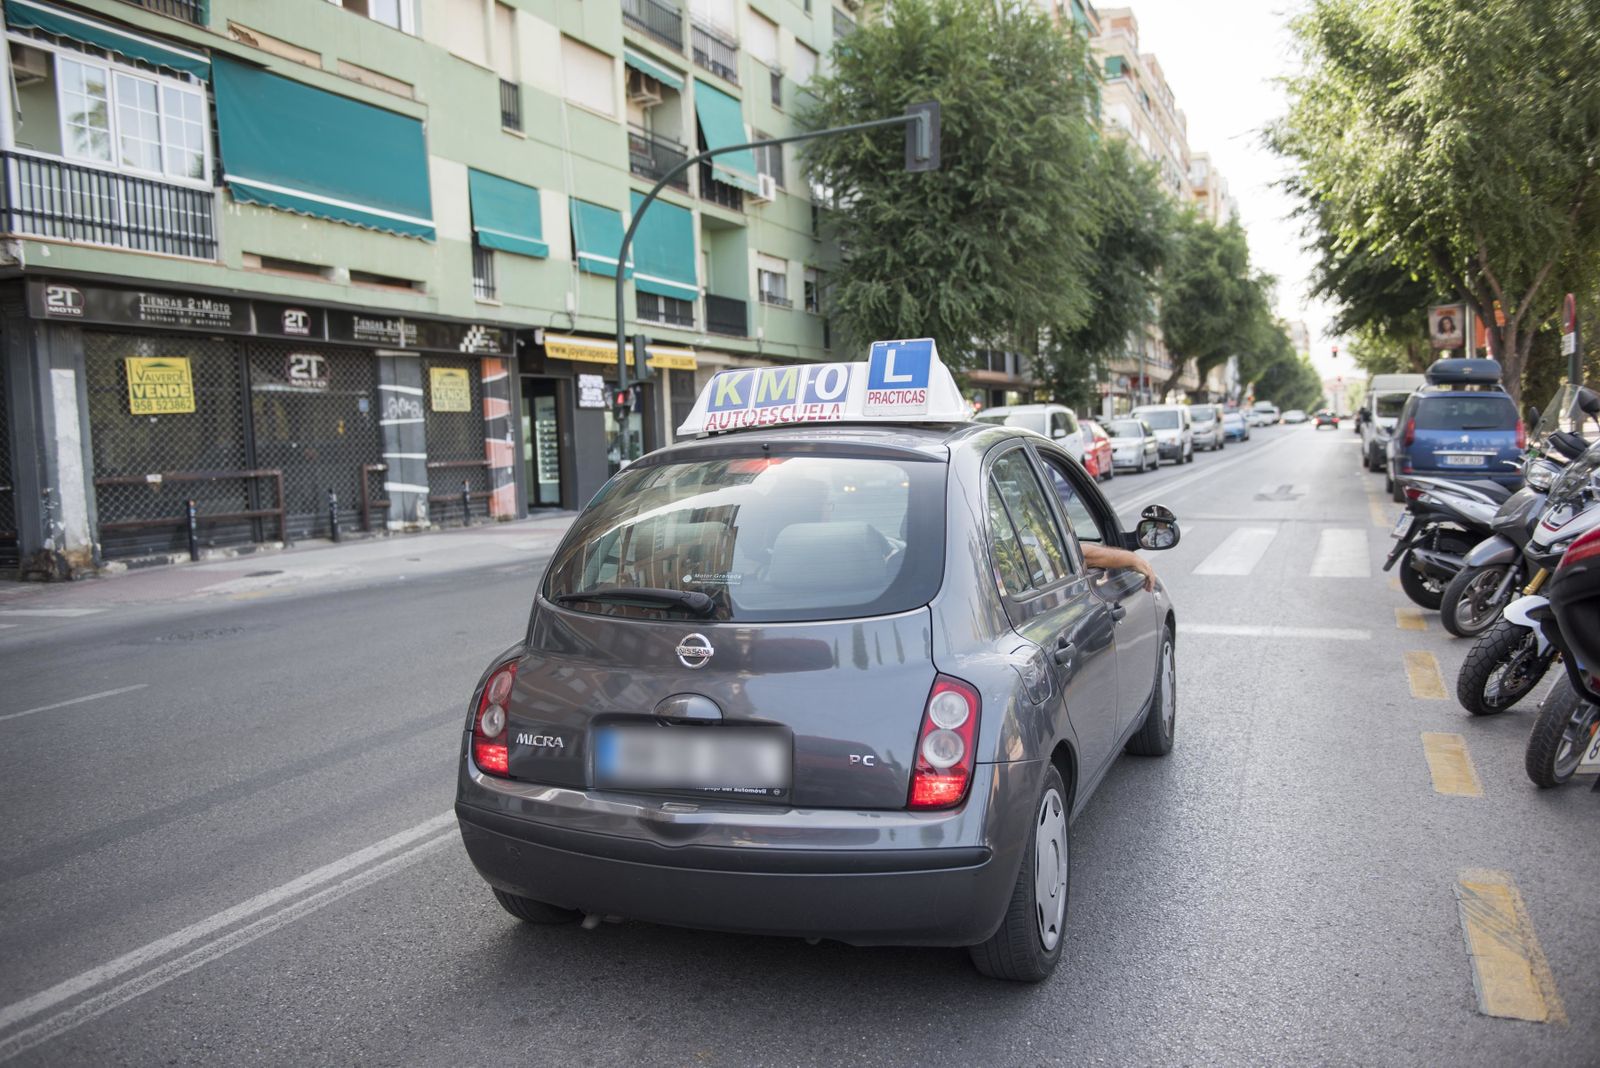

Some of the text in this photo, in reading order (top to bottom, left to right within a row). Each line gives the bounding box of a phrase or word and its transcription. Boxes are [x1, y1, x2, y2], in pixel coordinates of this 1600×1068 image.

[47, 286, 79, 306] 2T
[49, 306, 81, 314] MOTO
[284, 309, 308, 327] 2T
[290, 353, 325, 379] 2T
[883, 349, 913, 383] L
[291, 379, 327, 388] MOTO
[132, 384, 191, 399] VENDE
[867, 390, 926, 405] PRACTICAS
[134, 400, 153, 411] 958
[705, 403, 840, 430] AUTOESCUELA
[678, 647, 711, 655] NISSAN
[515, 733, 564, 749] MICRA
